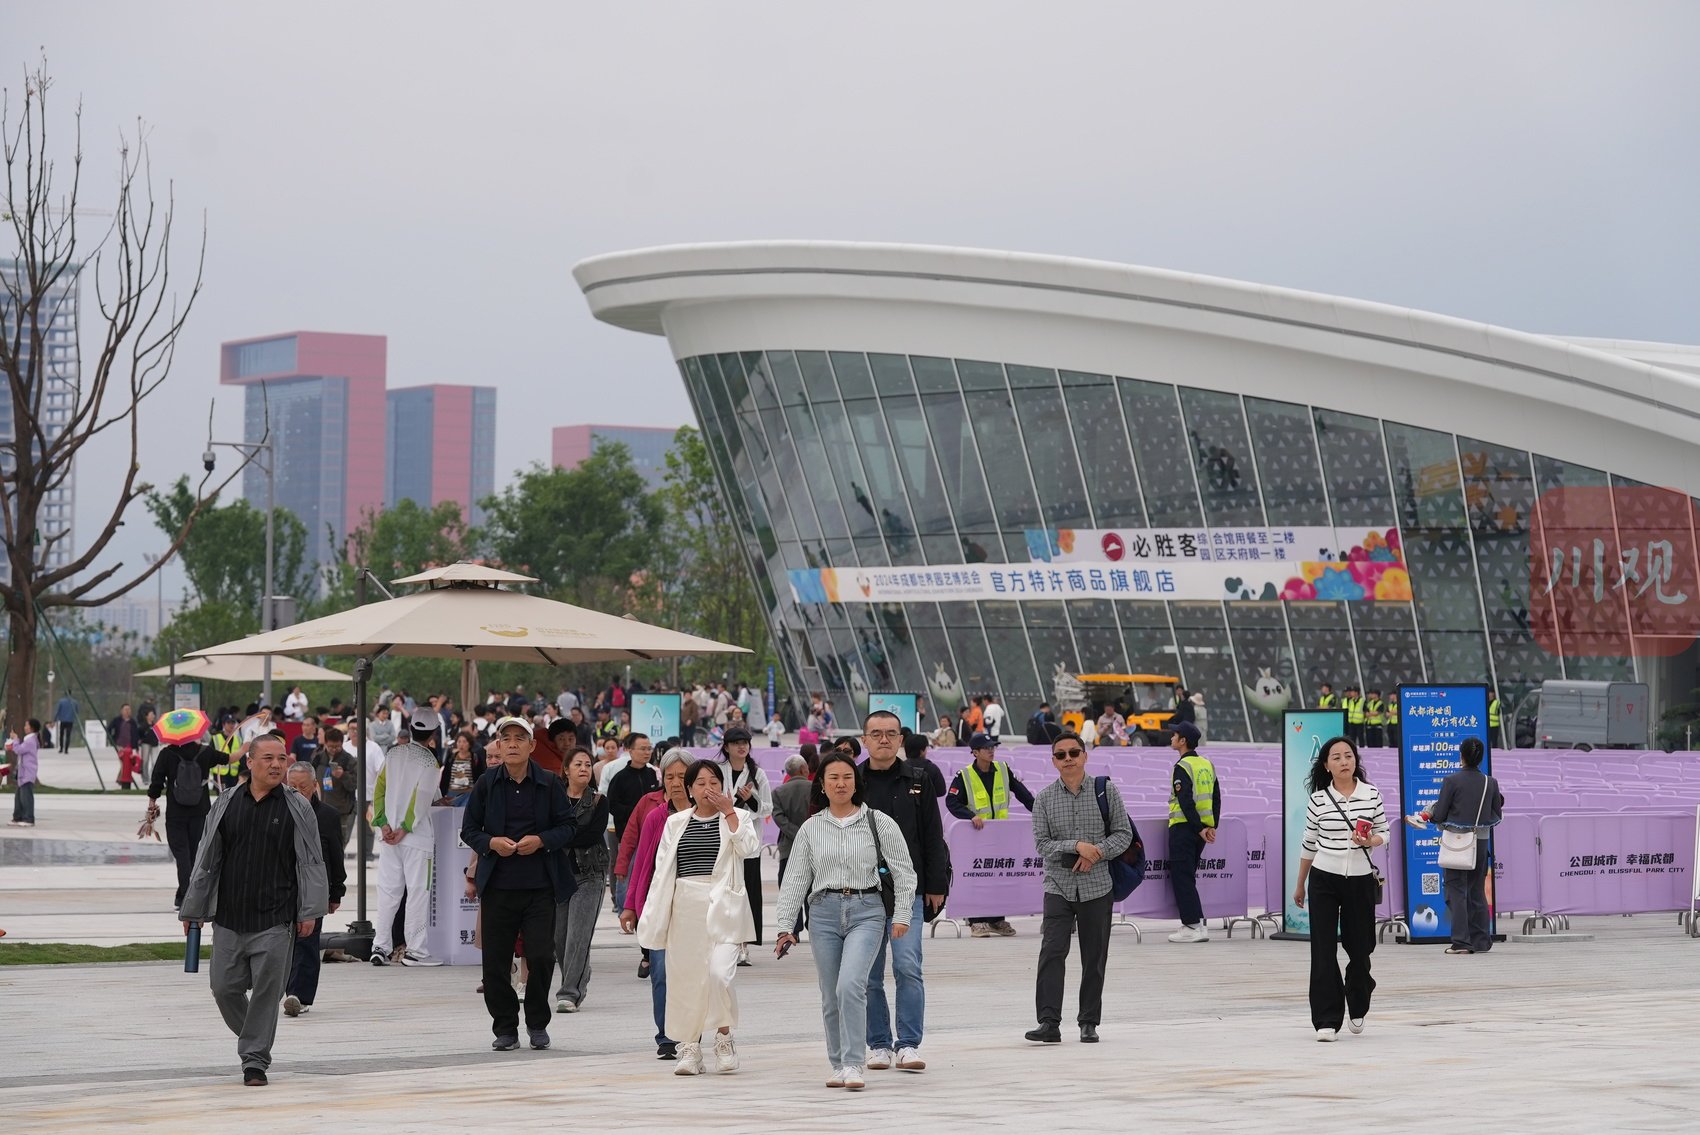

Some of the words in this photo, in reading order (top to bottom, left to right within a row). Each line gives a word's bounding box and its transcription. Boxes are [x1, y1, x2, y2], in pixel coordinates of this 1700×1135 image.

[1132, 533, 1198, 558] 必胜客
[1197, 531, 1295, 546] 综合馆用餐至二楼
[990, 568, 1176, 593] 官方特许商品旗舰店
[973, 858, 1015, 869] 公园城市
[1569, 854, 1618, 867] 公园城市
[1626, 853, 1675, 865] 幸福成都
[1559, 869, 1597, 877] CHENGDU:
